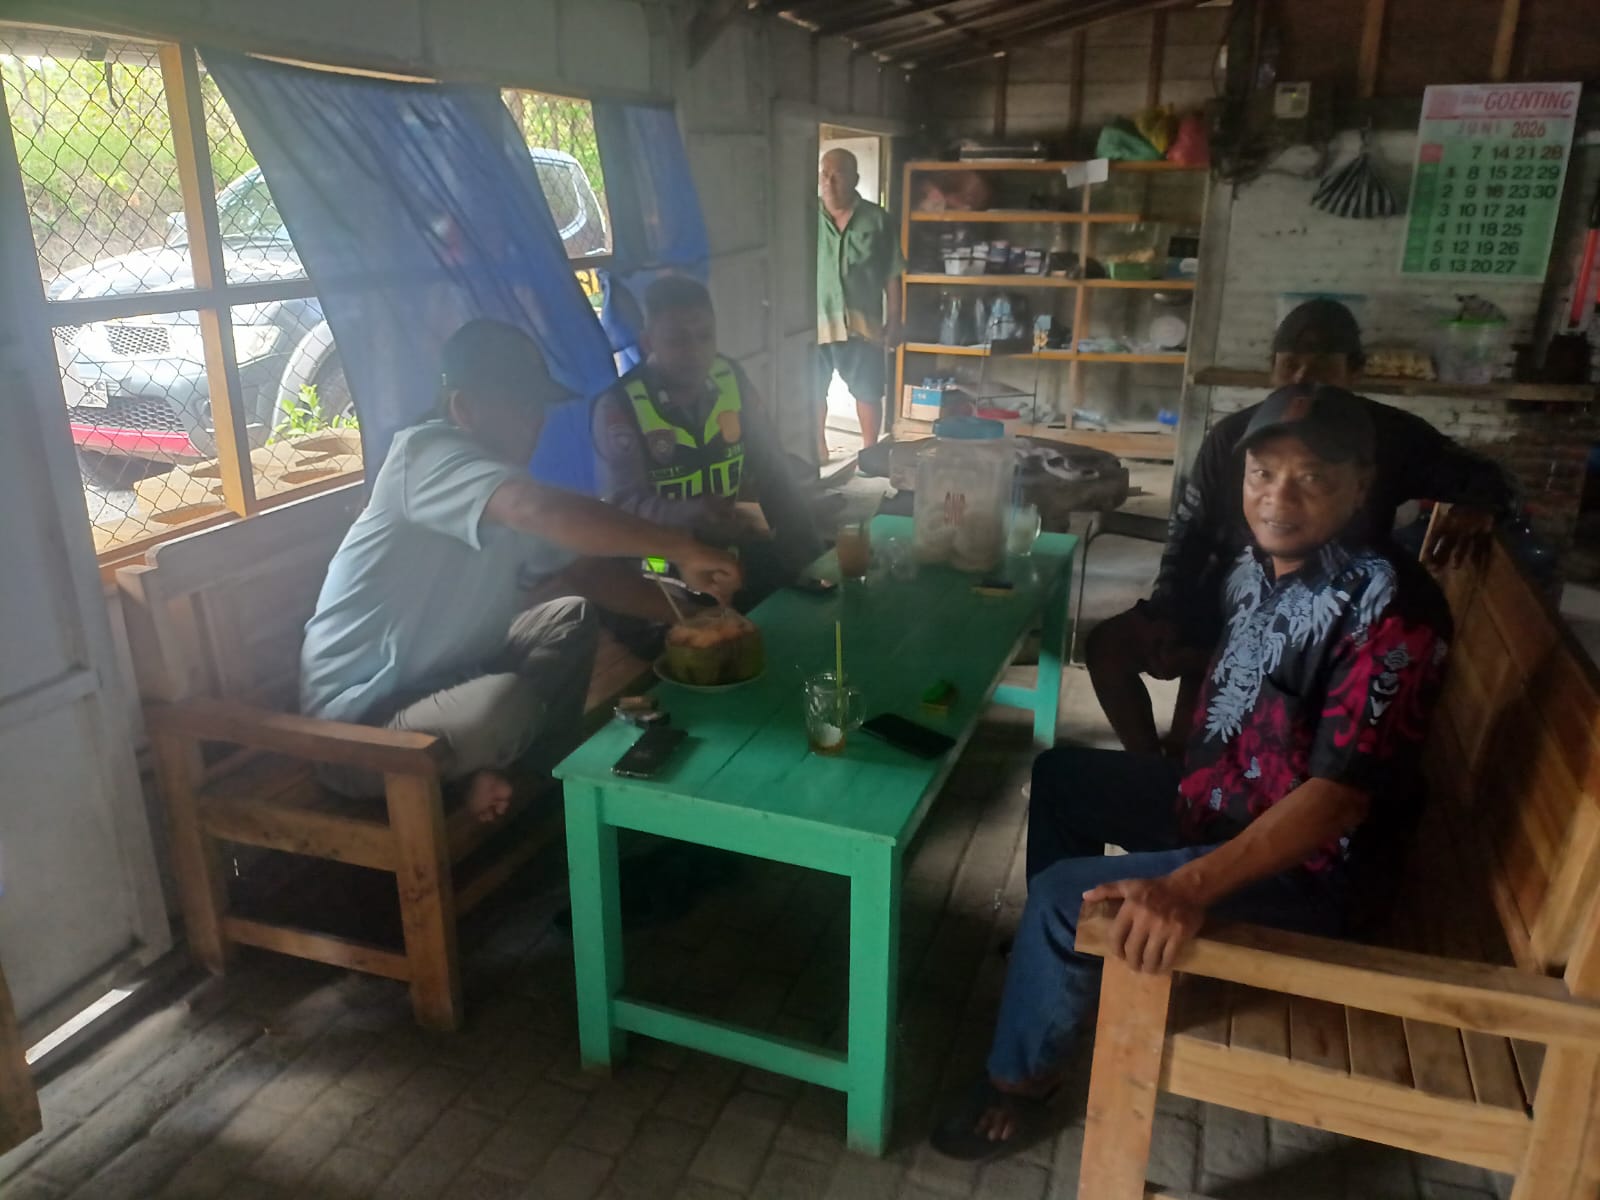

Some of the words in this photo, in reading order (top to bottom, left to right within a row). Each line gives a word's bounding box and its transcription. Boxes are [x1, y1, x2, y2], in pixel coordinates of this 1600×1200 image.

[1485, 91, 1573, 111] GOENTING
[1512, 121, 1546, 138] 2026
[1473, 146, 1484, 159] 7
[1493, 146, 1509, 159] 14
[1515, 146, 1534, 159] 21
[1468, 166, 1480, 180] 8
[1490, 166, 1507, 180] 15
[1512, 166, 1533, 180] 22
[1537, 166, 1560, 180] 29
[1442, 186, 1453, 198] 2
[1465, 185, 1476, 198] 9
[1508, 185, 1529, 198] 23
[1533, 185, 1556, 199] 30
[1439, 204, 1450, 217] 3
[1459, 204, 1475, 217] 10
[1484, 204, 1499, 217] 17
[1504, 204, 1526, 218] 24
[1436, 223, 1446, 235] 4
[1456, 223, 1470, 235] 11
[1480, 223, 1497, 236] 18
[1501, 223, 1523, 237] 25
[1433, 241, 1443, 254] 5
[1453, 241, 1469, 254] 12
[1477, 241, 1494, 254] 19
[1499, 241, 1519, 254] 26
[1430, 259, 1440, 272] 6
[1450, 259, 1465, 272] 13
[1470, 259, 1491, 273] 20
[1494, 259, 1517, 273] 27
